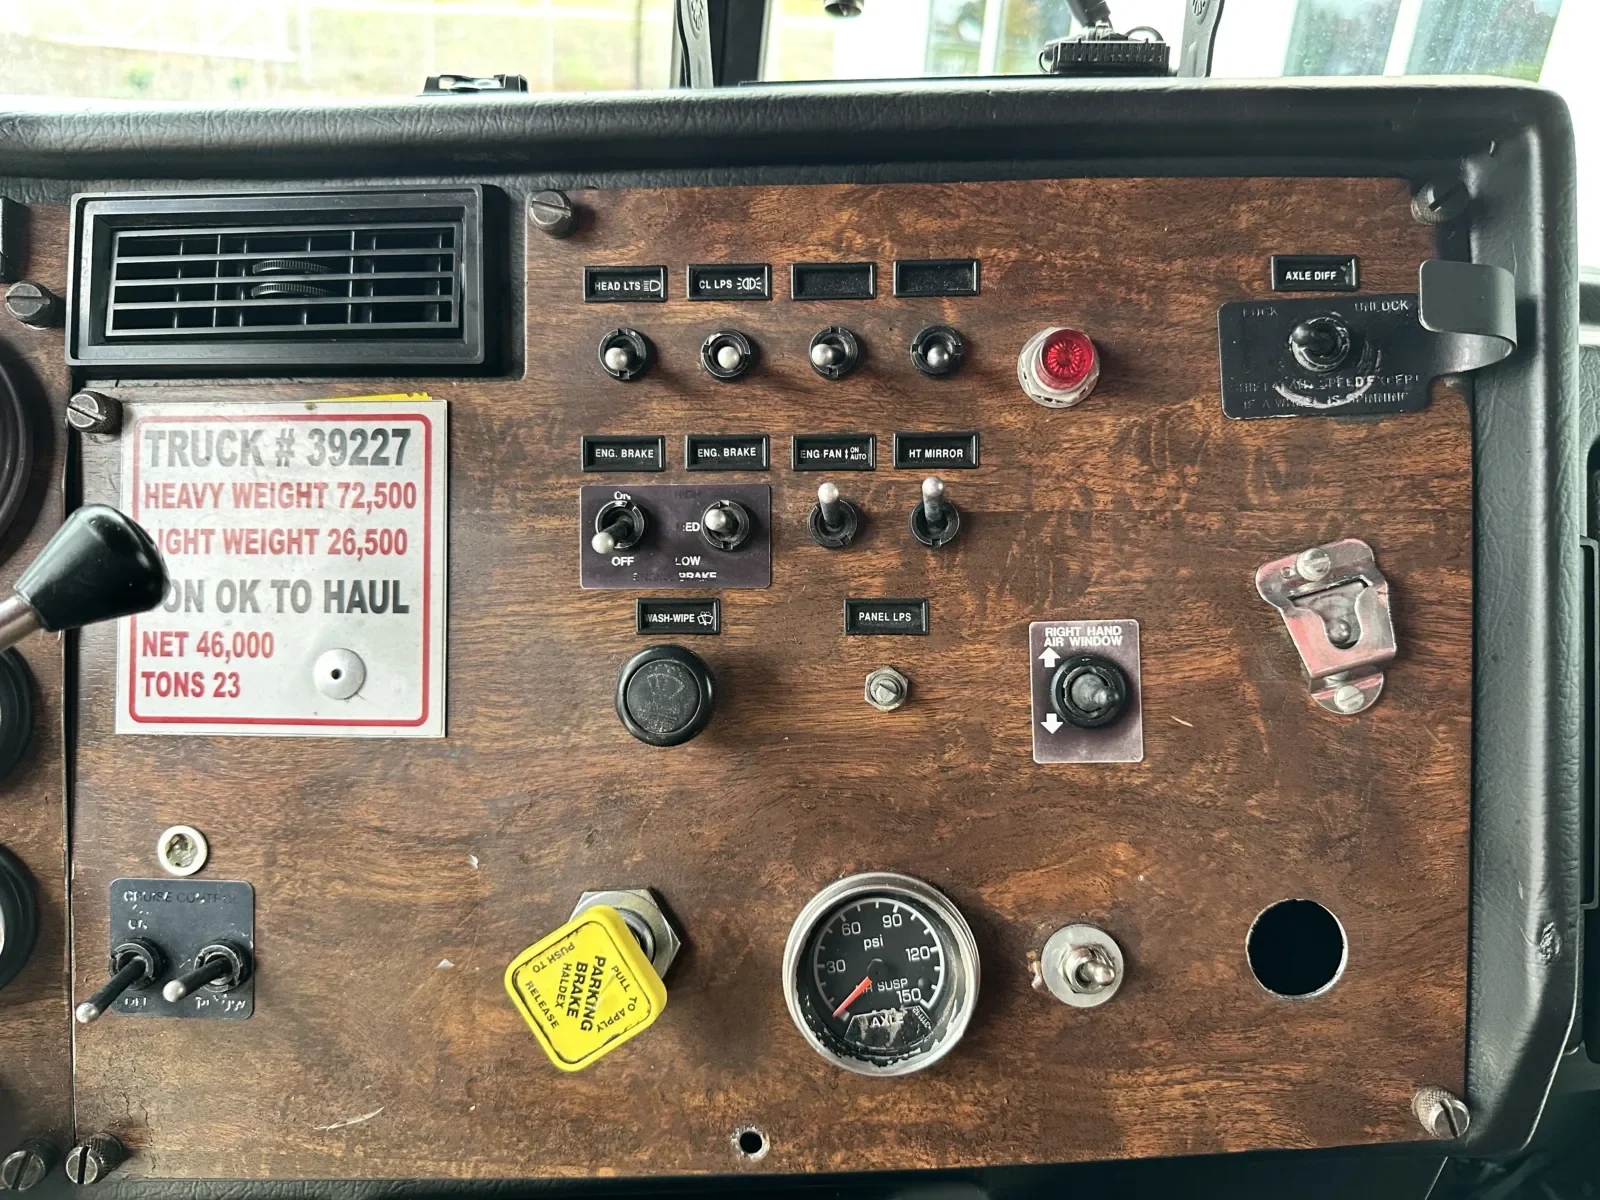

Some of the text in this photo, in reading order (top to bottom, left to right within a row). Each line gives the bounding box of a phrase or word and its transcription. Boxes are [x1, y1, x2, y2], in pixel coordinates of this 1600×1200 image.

[1285, 271, 1337, 281] AXLE DIFF
[595, 281, 641, 291] HEAD LTS
[699, 279, 733, 289] CL LPS
[1354, 300, 1409, 312] UNLOCK
[144, 427, 412, 467] TRUCK # 39227
[595, 449, 654, 459] ENG. BRAKE
[697, 447, 757, 458] ENG. BRAKE
[909, 449, 964, 458] HT MIRROR
[801, 450, 842, 459] ENG FAN
[144, 481, 417, 514] HEAVY WEIGHT 72,500
[148, 528, 407, 560] IGHT WEIGHT 26,500
[611, 556, 634, 567] OFF
[675, 556, 701, 566] LOW
[679, 572, 717, 582] BRAKE
[215, 579, 261, 613] OK
[270, 579, 312, 613] TO
[324, 579, 410, 613] HAUL
[645, 613, 695, 623] WASH-WIPE
[859, 612, 912, 622] PANEL LPS
[1045, 626, 1122, 637] RIGHT HAND
[142, 631, 274, 664] NET 46,000
[1044, 636, 1123, 647] AIR WINDOW
[141, 671, 241, 698] TONS 23
[882, 913, 903, 928] 90
[842, 922, 861, 936] 60
[863, 934, 884, 951] psi
[905, 945, 931, 961] 120
[827, 959, 846, 972] 30
[525, 941, 576, 1029] PUSH TO RELEASE
[555, 962, 572, 1010] HALDEX
[566, 961, 589, 1018] BRAKE
[877, 978, 908, 992] SUSP
[580, 955, 607, 1032] PARKING
[596, 965, 638, 1033] PULL TO APPLY
[897, 987, 922, 1003] 150
[871, 1014, 904, 1028] AXLE
